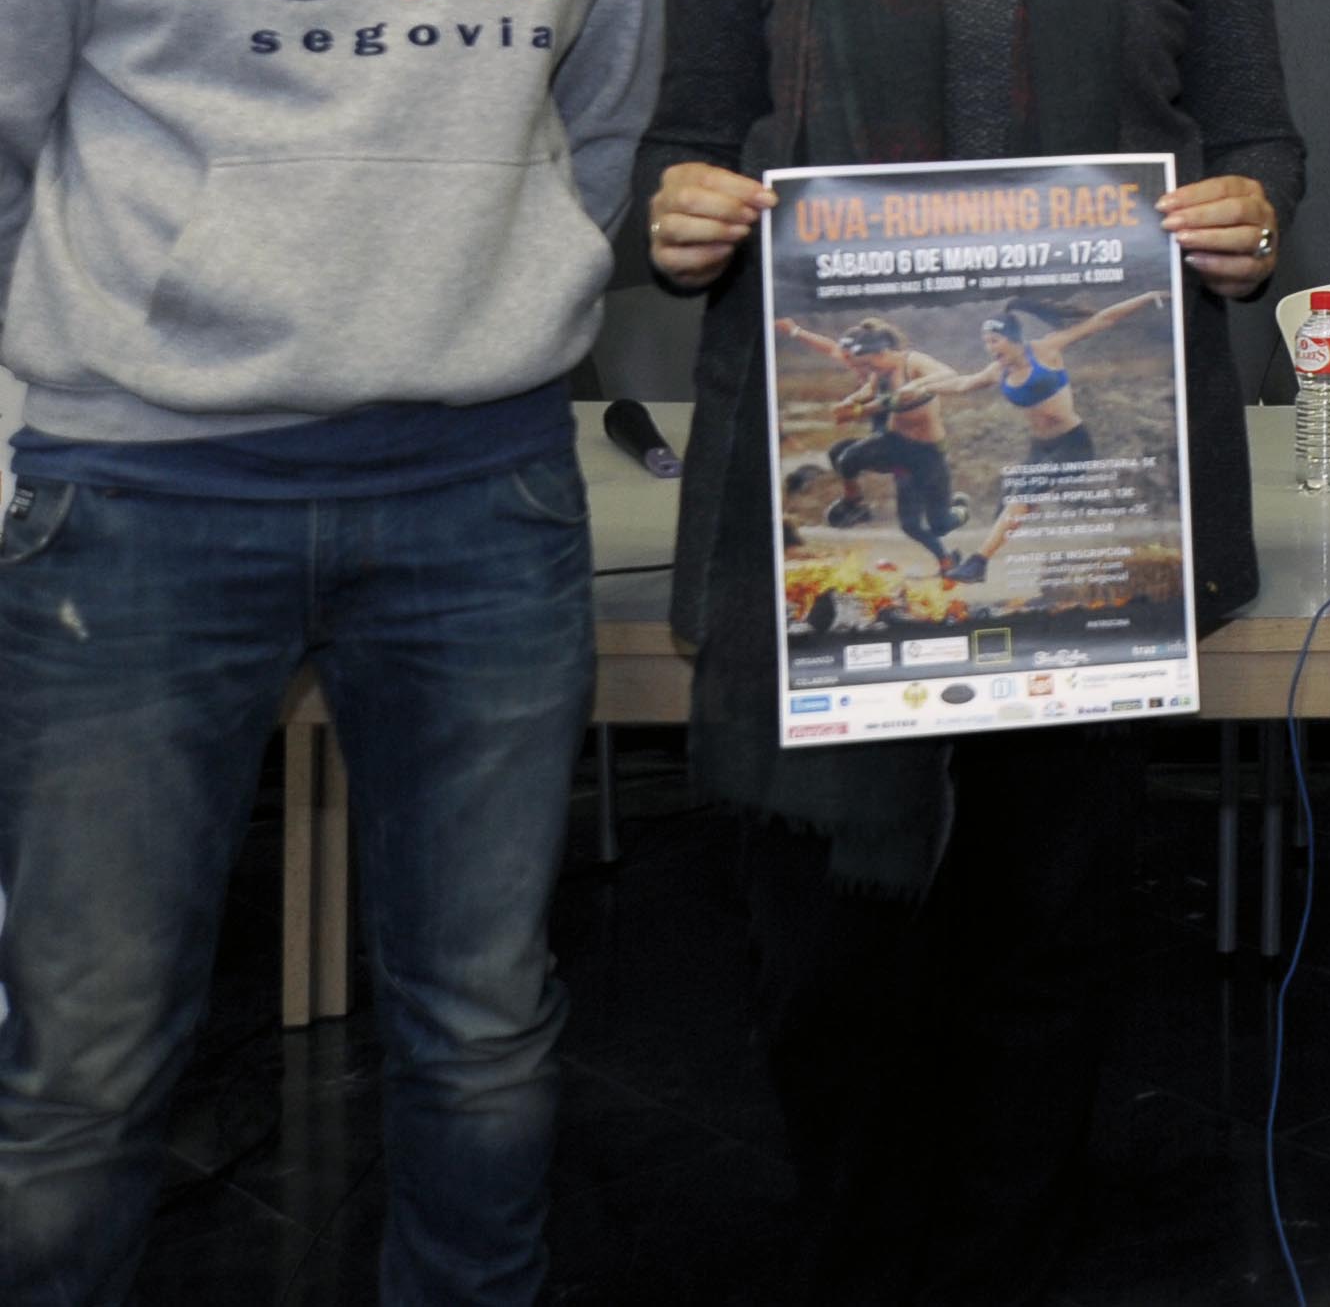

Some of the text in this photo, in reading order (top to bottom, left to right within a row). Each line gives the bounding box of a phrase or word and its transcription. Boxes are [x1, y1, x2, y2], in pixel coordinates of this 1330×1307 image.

[250, 17, 553, 56] segovia
[794, 183, 1140, 242] UVA-RUNNING RACE
[816, 248, 895, 279] SÁBADO
[898, 250, 912, 275] 6
[914, 248, 941, 273] DE
[943, 245, 997, 271] MAYO
[1000, 243, 1050, 269] 2017
[1068, 239, 1122, 265] 17:30
